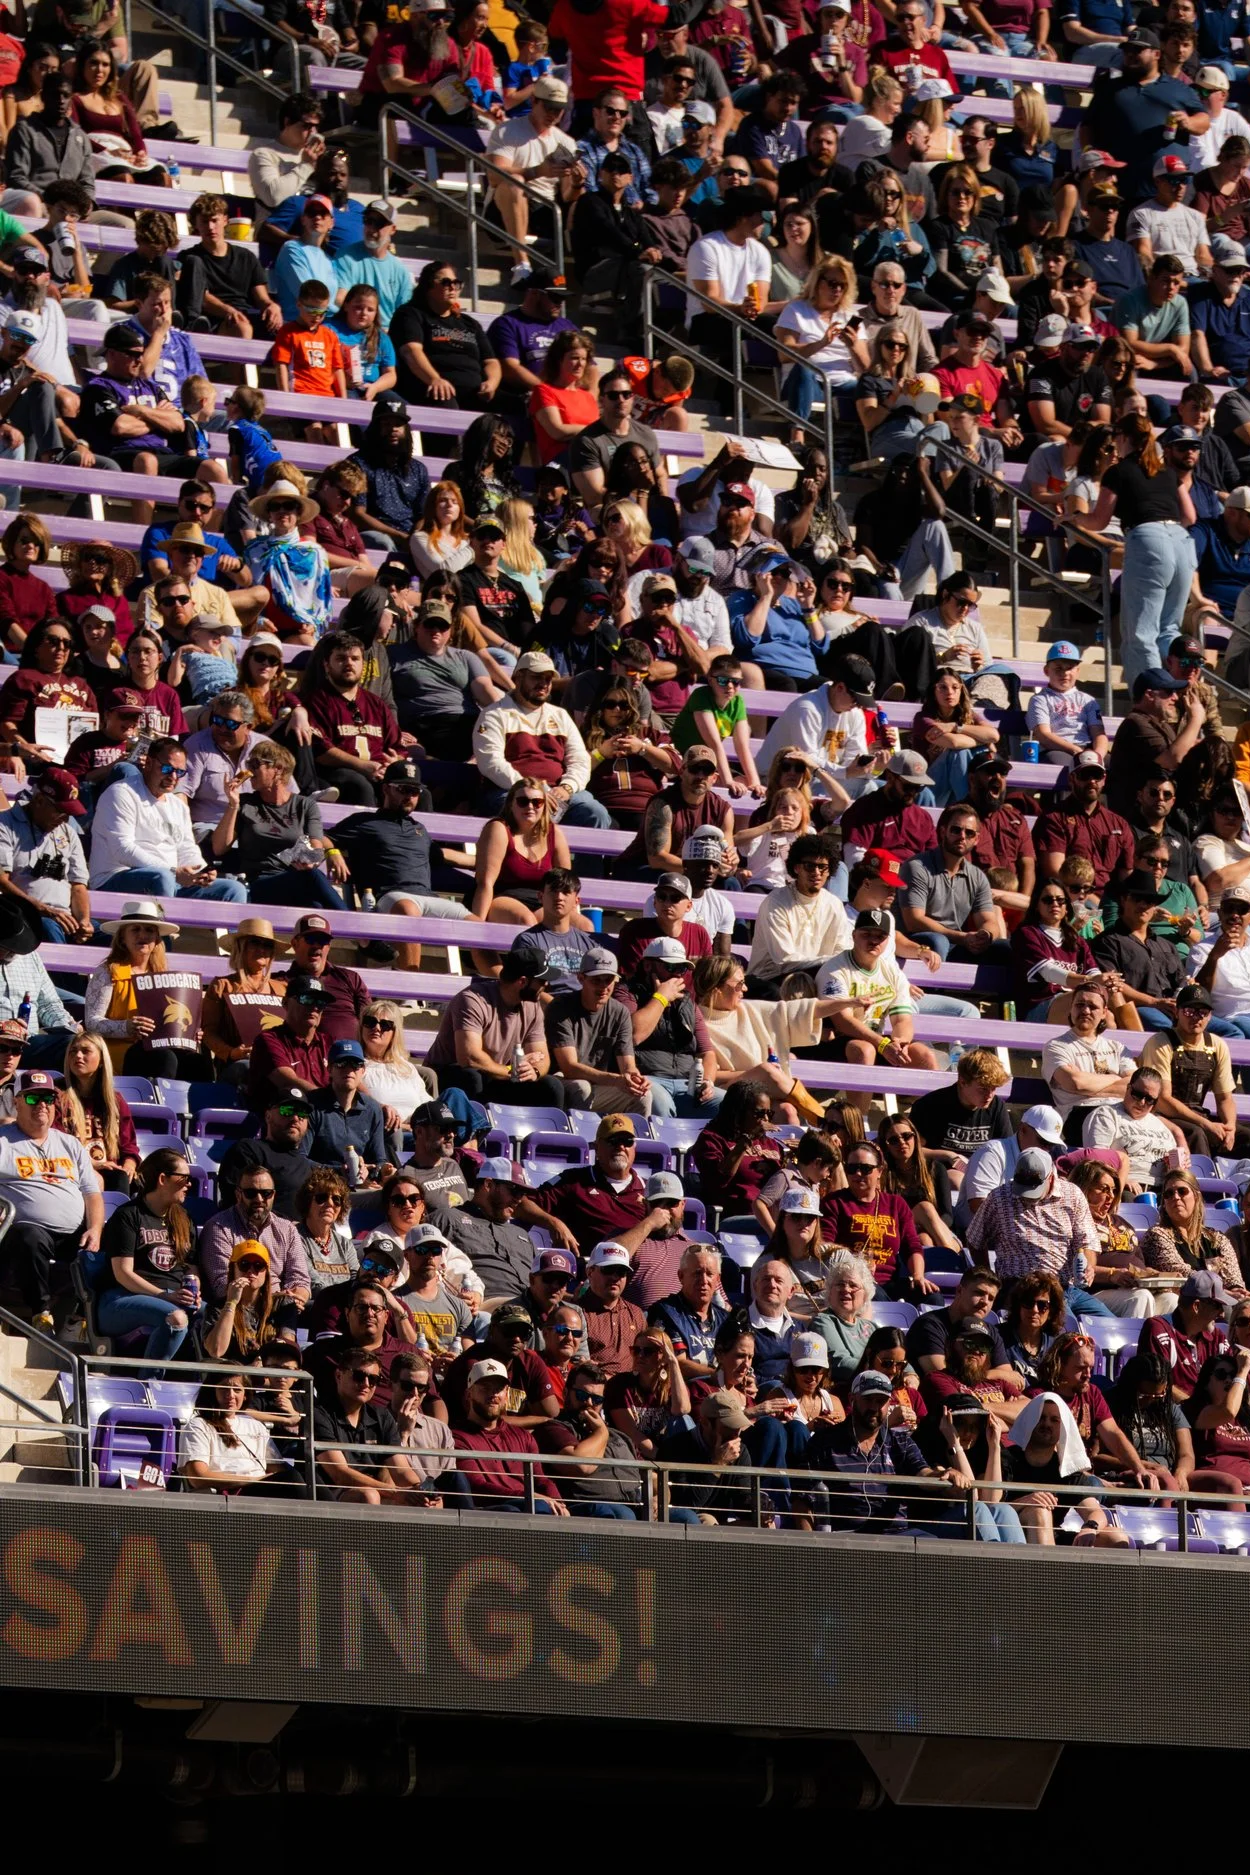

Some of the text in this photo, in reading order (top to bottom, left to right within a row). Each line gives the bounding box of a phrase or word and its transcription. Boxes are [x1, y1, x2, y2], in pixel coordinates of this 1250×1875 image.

[137, 972, 201, 990] GO BOBCATS!
[229, 994, 246, 1006] GO
[151, 1038, 170, 1049] BOWL
[947, 1127, 990, 1143] GUYER
[2, 1528, 660, 1690] SAVINGS!
